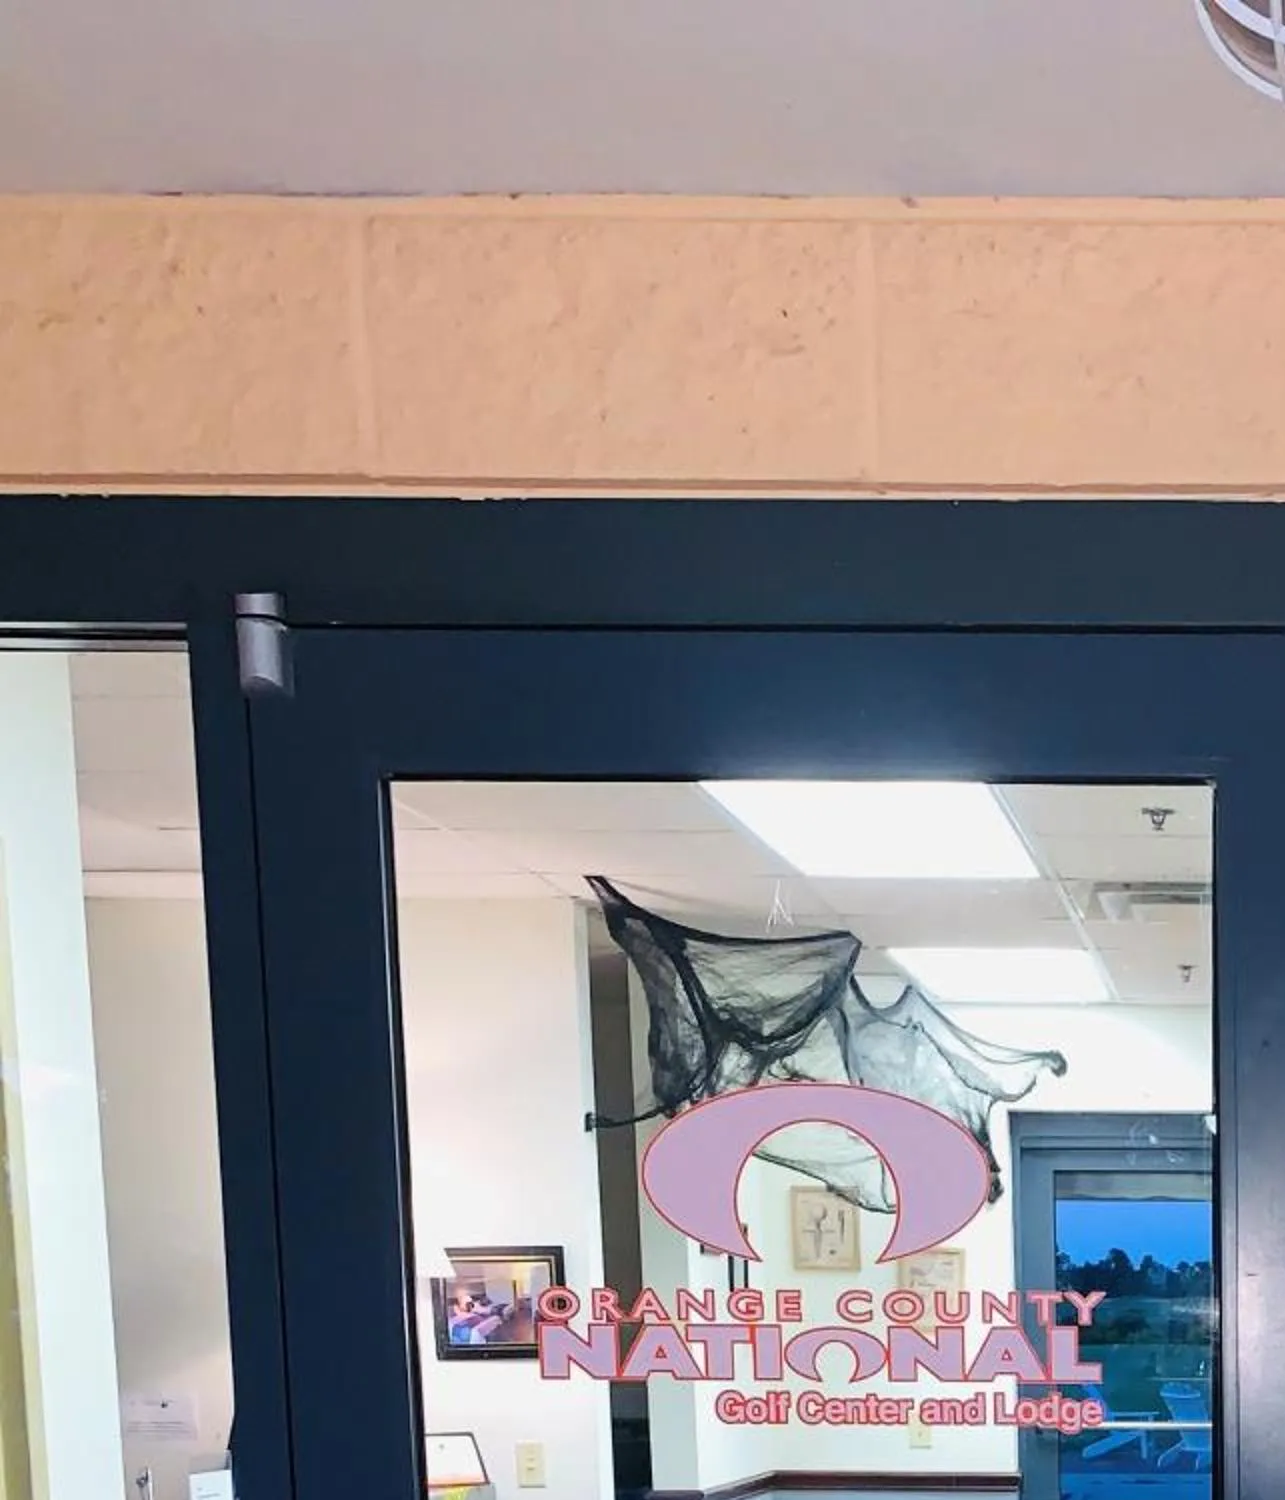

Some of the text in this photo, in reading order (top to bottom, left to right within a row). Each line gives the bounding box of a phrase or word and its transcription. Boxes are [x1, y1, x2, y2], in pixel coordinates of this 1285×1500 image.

[537, 1285, 1108, 1326] ORANGE COUNTY
[538, 1323, 1105, 1384] NATIONAL
[715, 1390, 1105, 1435] Golf Center and Lodge
